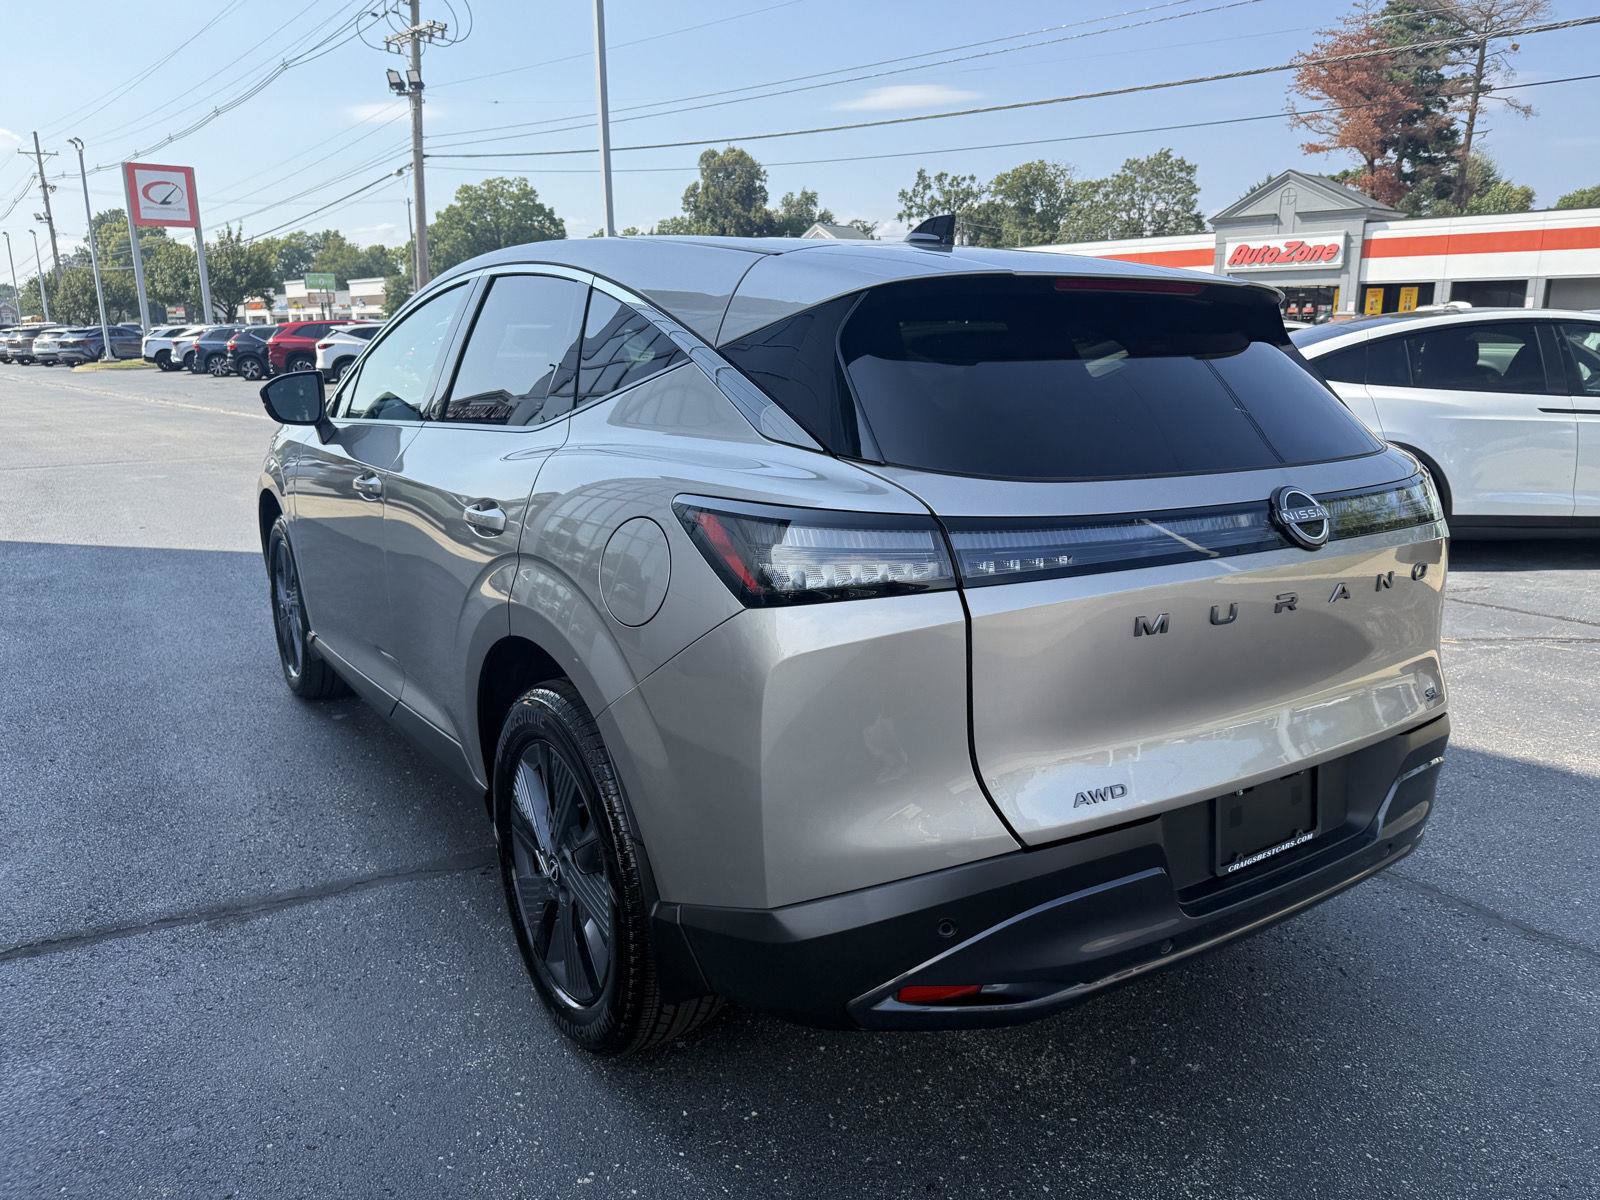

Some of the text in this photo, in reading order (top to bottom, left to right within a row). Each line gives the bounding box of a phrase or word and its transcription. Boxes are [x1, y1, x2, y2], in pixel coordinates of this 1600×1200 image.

[1228, 241, 1340, 266] AutoZone
[1283, 508, 1329, 521] NISSAN
[1133, 561, 1429, 637] MURANO
[1073, 784, 1128, 808] AWD
[1228, 833, 1313, 872] CRAIGSBESTCARS.COM
